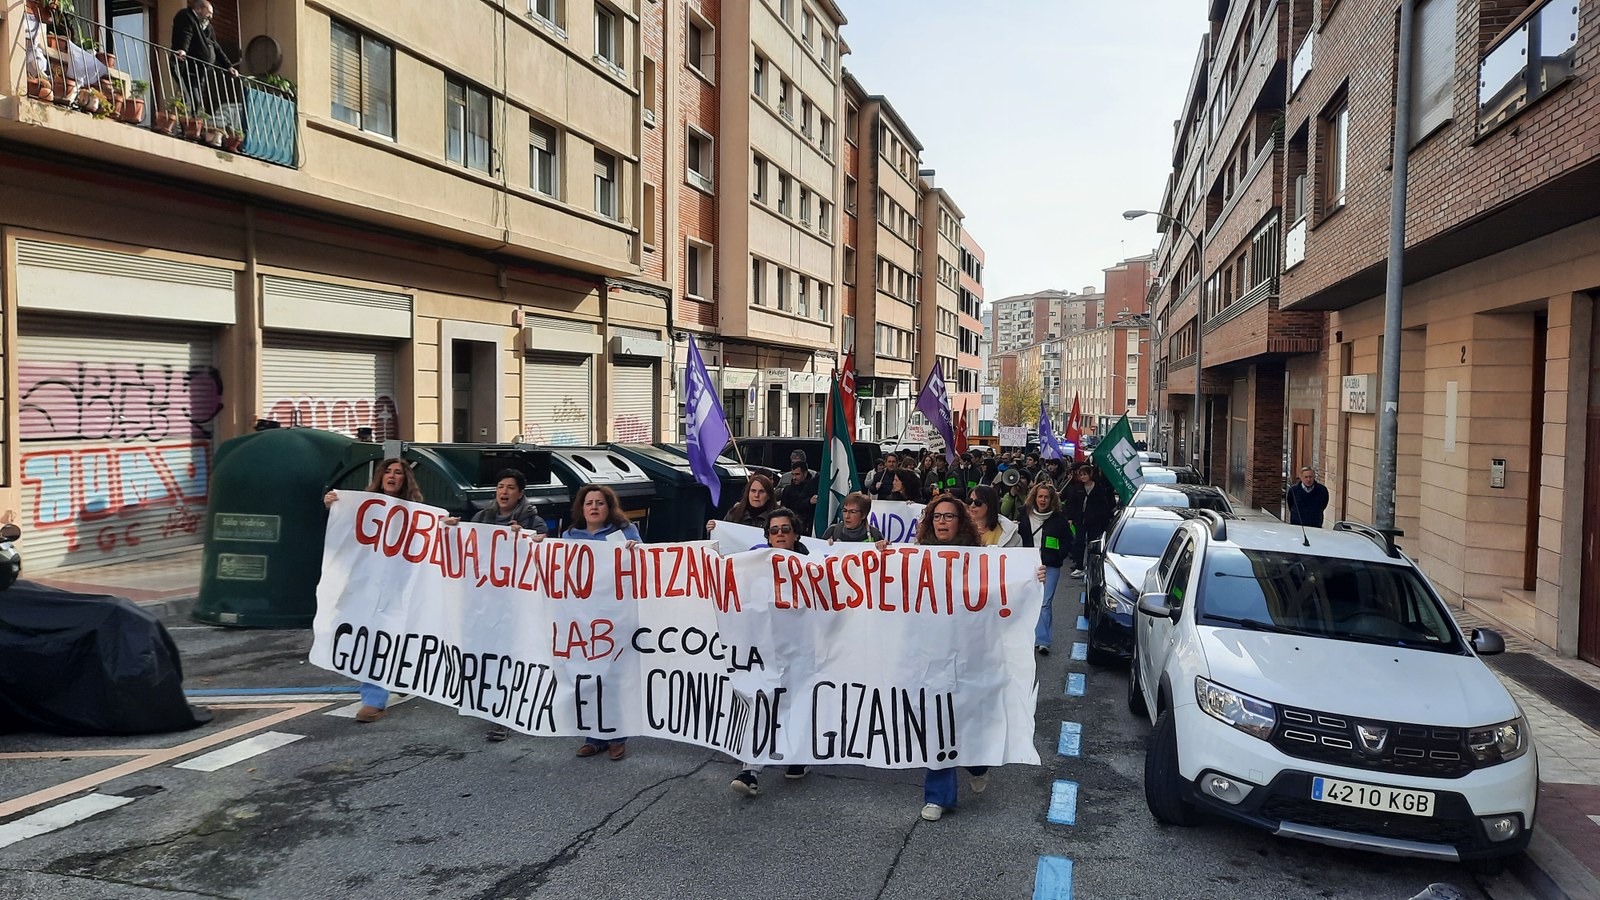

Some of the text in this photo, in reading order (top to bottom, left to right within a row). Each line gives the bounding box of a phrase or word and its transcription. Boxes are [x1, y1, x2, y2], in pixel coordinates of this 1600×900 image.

[1460, 345, 1467, 364] 2
[1350, 391, 1366, 411] ERICE
[1106, 453, 1123, 476] EUSKAL
[772, 547, 1012, 618] ERRESPETATU!
[552, 619, 624, 662] LAB,
[458, 652, 558, 733] RESPETA
[576, 674, 617, 733] EL
[752, 687, 788, 761] DE
[812, 681, 959, 766] GIZAIN!!
[1327, 783, 1382, 807] 4210
[1388, 791, 1429, 813] KGB
